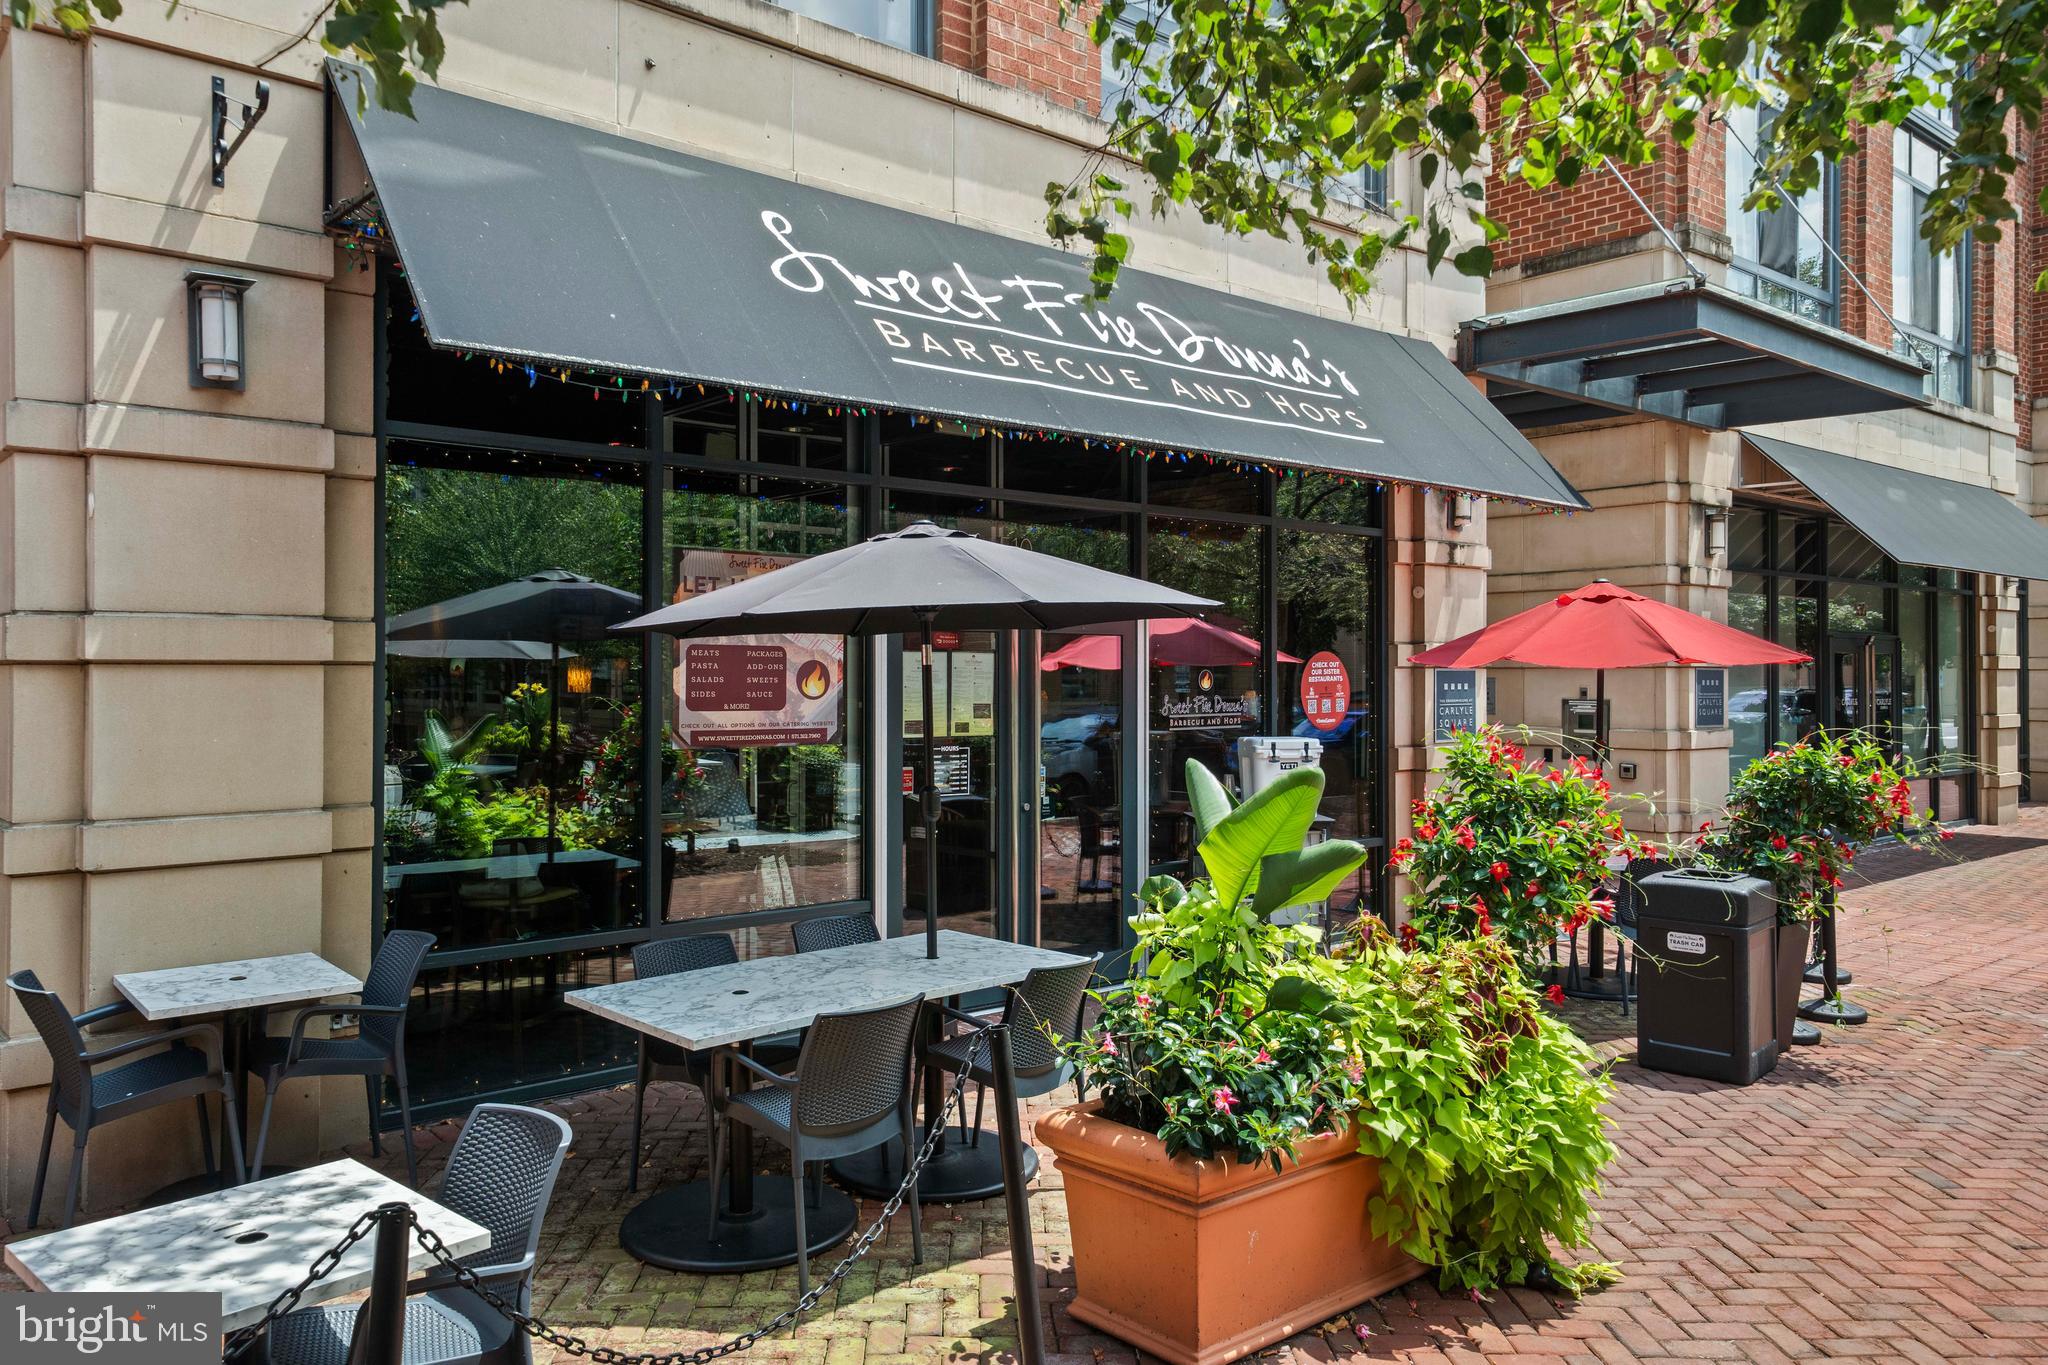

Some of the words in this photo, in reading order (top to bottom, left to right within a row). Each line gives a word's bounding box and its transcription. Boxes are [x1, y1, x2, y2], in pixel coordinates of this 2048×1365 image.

[761, 210, 1003, 322] Sweet
[1001, 275, 1162, 355] Fire
[1137, 302, 1360, 396] Donna's
[872, 318, 1149, 390] BARBECUE
[1170, 378, 1252, 409] AND
[1264, 391, 1368, 430] HOPS
[683, 575, 720, 593] LET
[1439, 706, 1473, 715] CARLYLE
[1698, 708, 1723, 716] SQUARE
[1169, 719, 1204, 727] BARBECUE
[1223, 717, 1241, 725] HOPS
[697, 733, 786, 742] WWW.SWEETFIREDONNAS.COM
